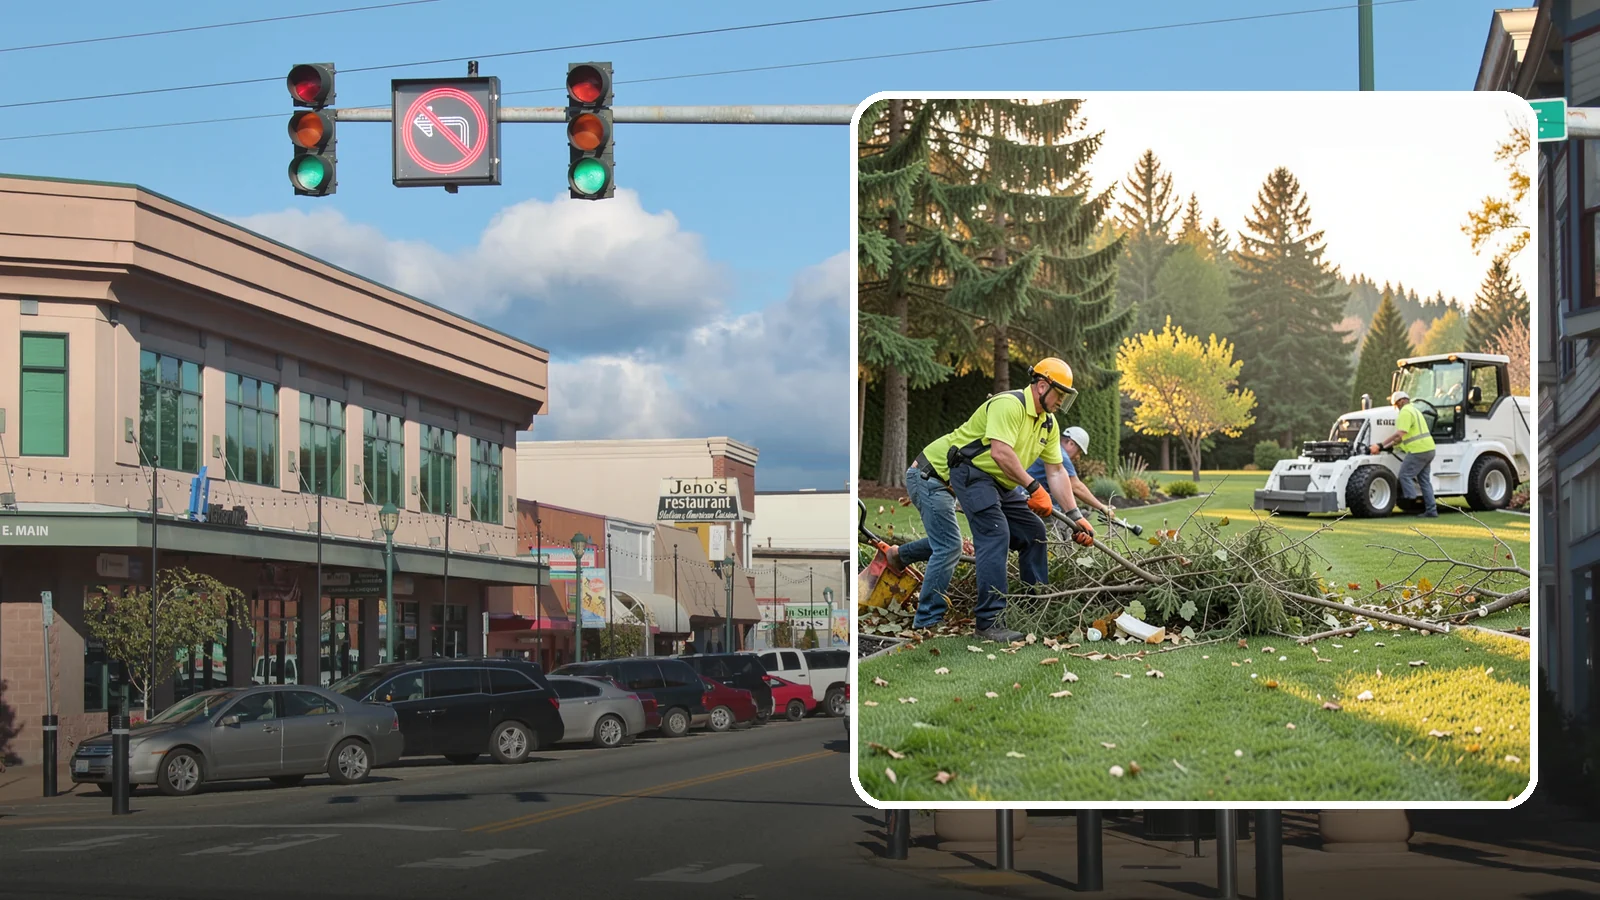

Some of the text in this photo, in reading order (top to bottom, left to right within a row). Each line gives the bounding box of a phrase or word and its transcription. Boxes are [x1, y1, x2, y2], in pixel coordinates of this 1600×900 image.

[669, 480, 728, 494] Jeno's
[665, 496, 731, 509] restaurant
[658, 509, 682, 519] Italian
[686, 509, 714, 519] American
[714, 509, 738, 519] Cuisine
[2, 525, 49, 536] E. MAIN
[786, 607, 794, 616] in
[797, 607, 828, 616] Street
[791, 619, 823, 627] lass
